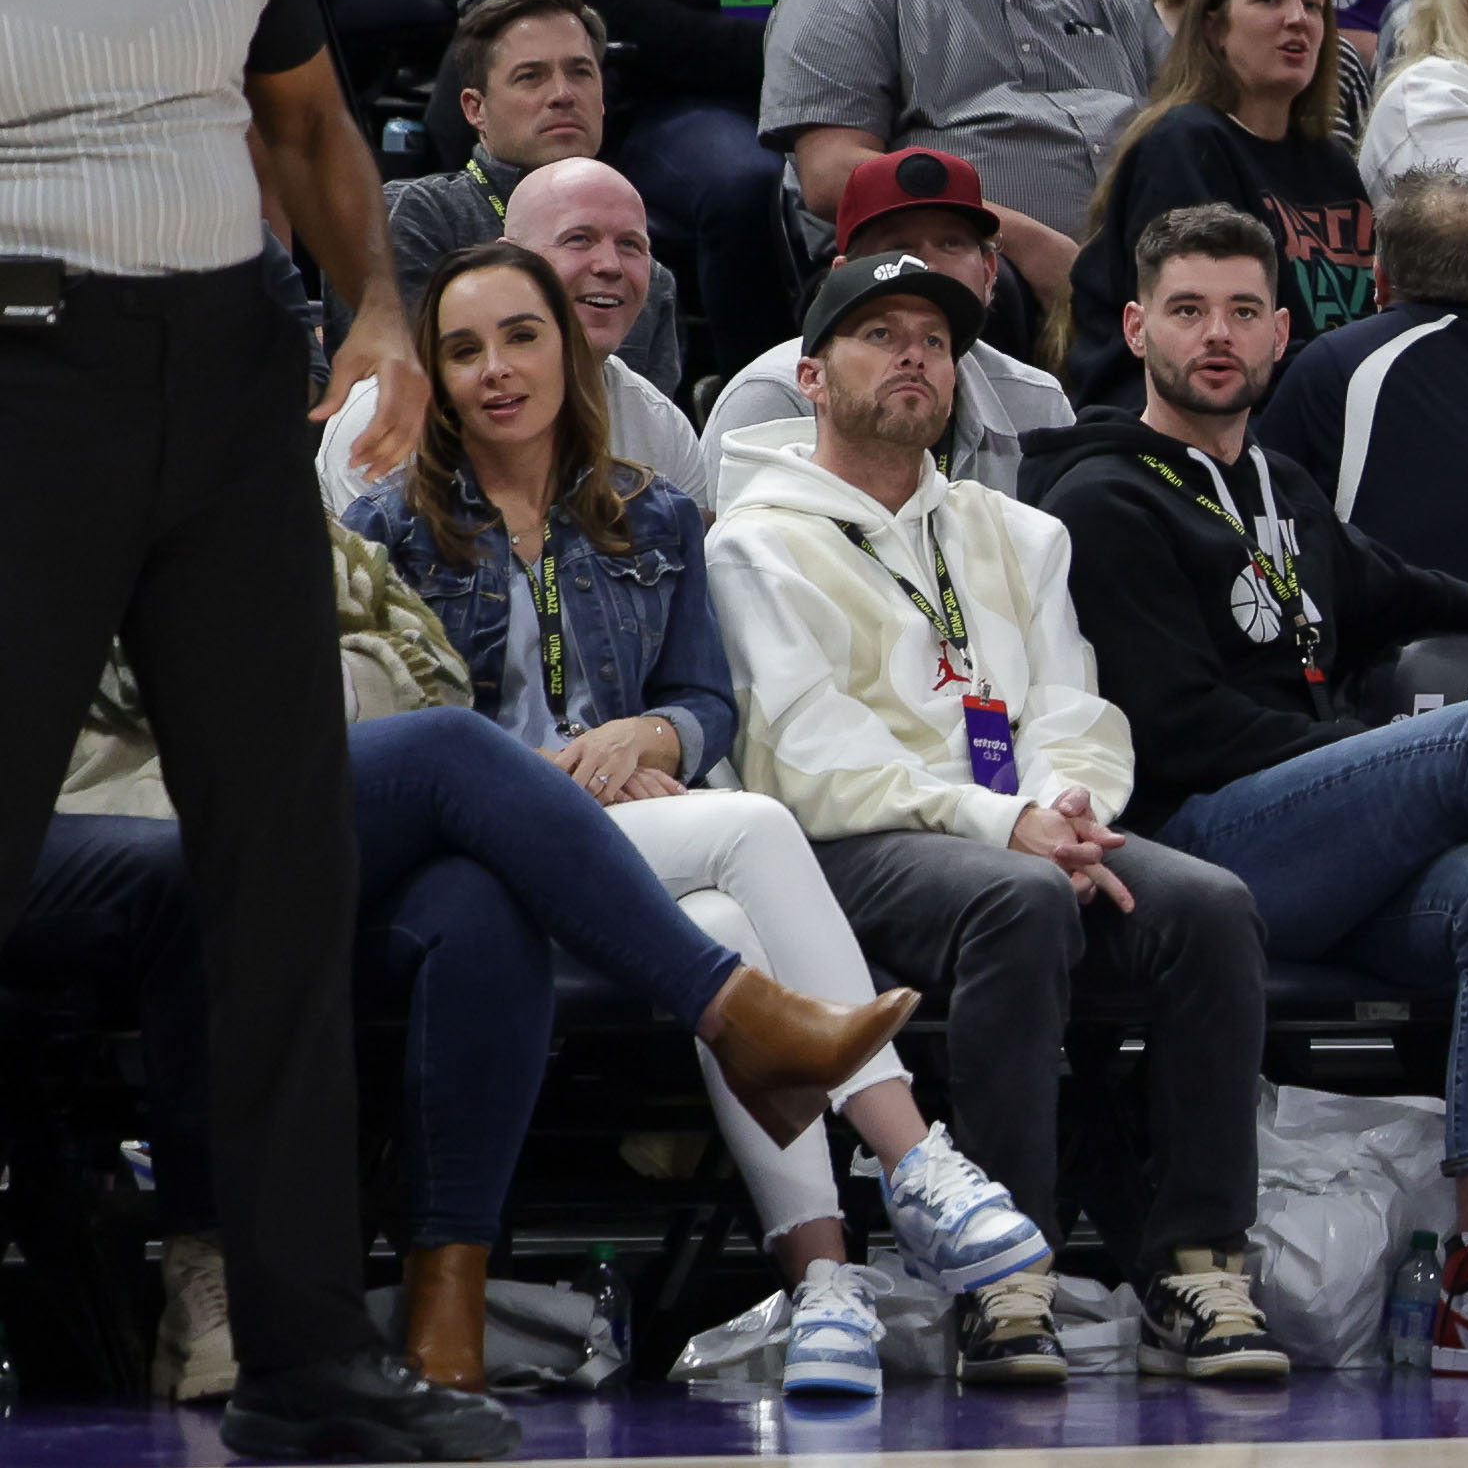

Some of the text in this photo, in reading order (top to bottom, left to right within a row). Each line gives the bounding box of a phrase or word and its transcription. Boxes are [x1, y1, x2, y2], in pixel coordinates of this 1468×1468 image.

[543, 556, 557, 583] UTAH
[546, 589, 560, 615] JAZZ
[911, 592, 933, 615] UTAH
[950, 614, 965, 638] UTAH
[549, 633, 563, 695] UTAH JAZZ
